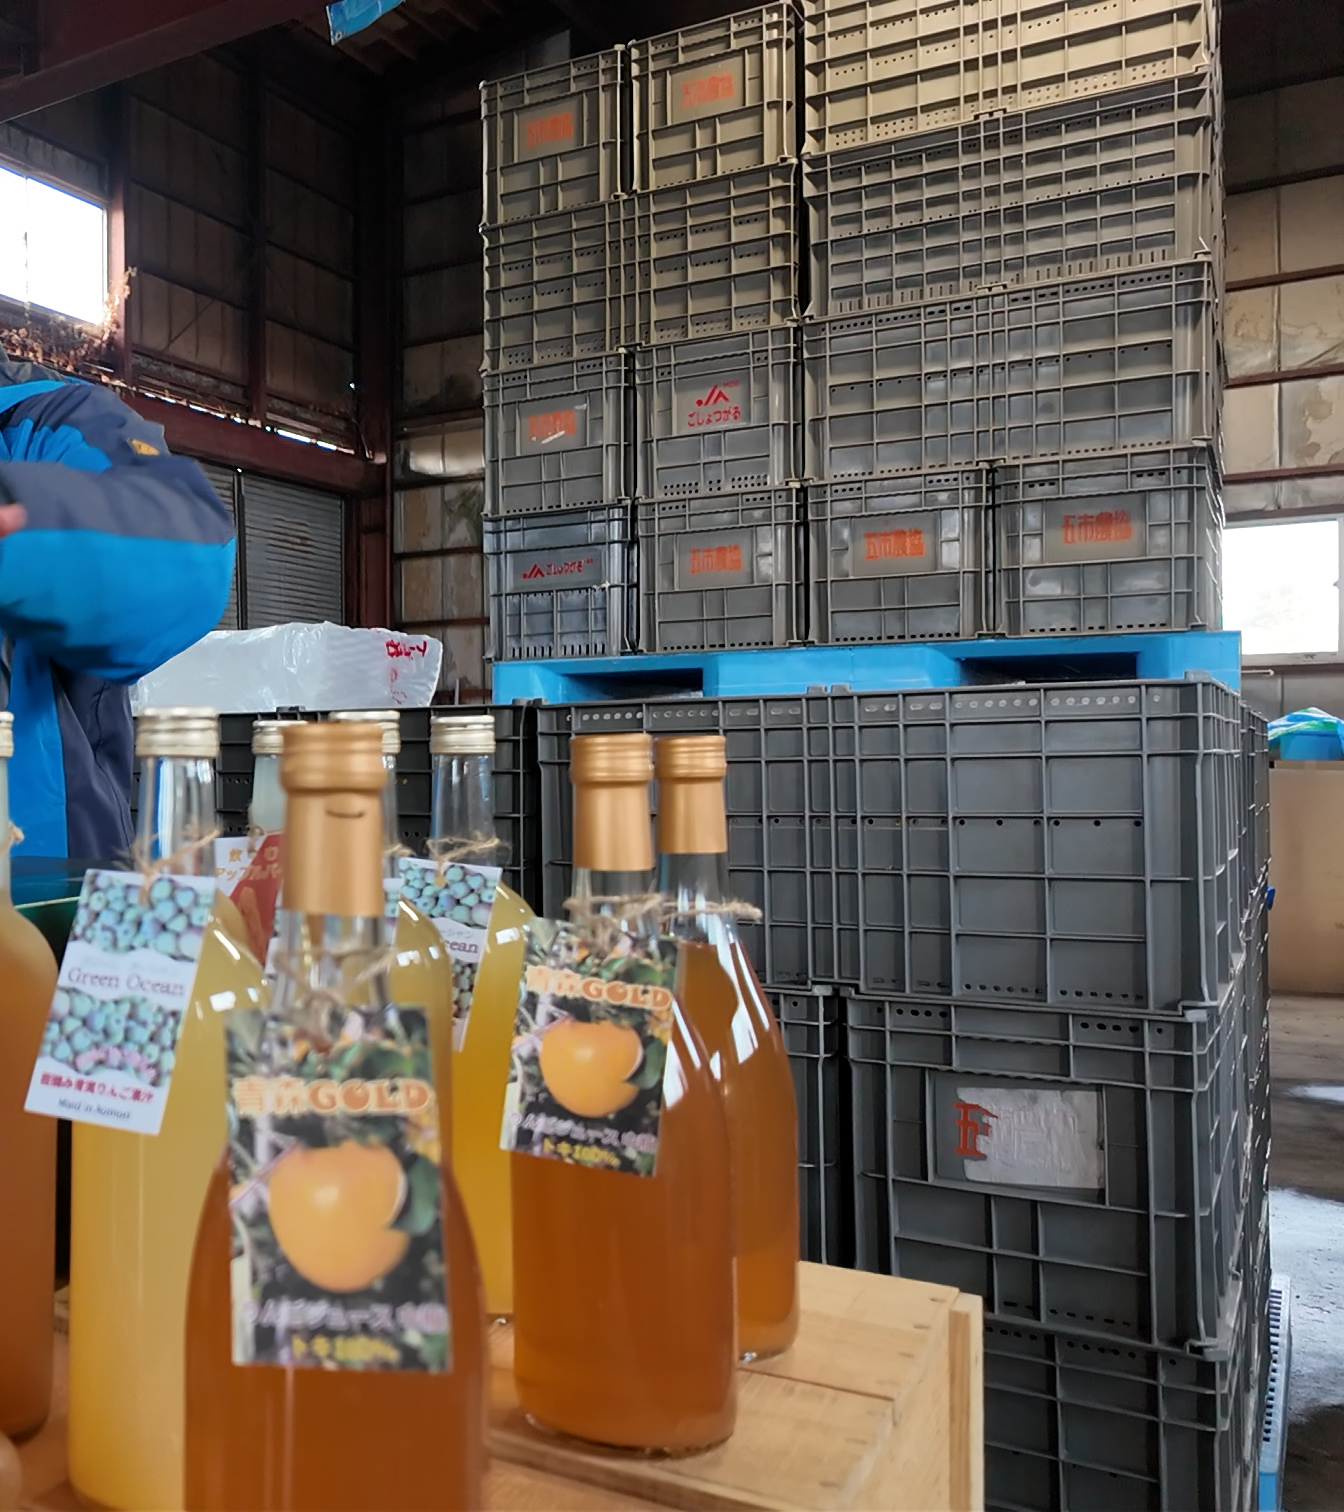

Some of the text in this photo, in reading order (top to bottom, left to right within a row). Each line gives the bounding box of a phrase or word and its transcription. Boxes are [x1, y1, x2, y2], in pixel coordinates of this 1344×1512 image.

[688, 406, 741, 427] ごしょつがる
[67, 967, 185, 996] Green Ocean
[233, 1076, 433, 1116] 青森GOLD
